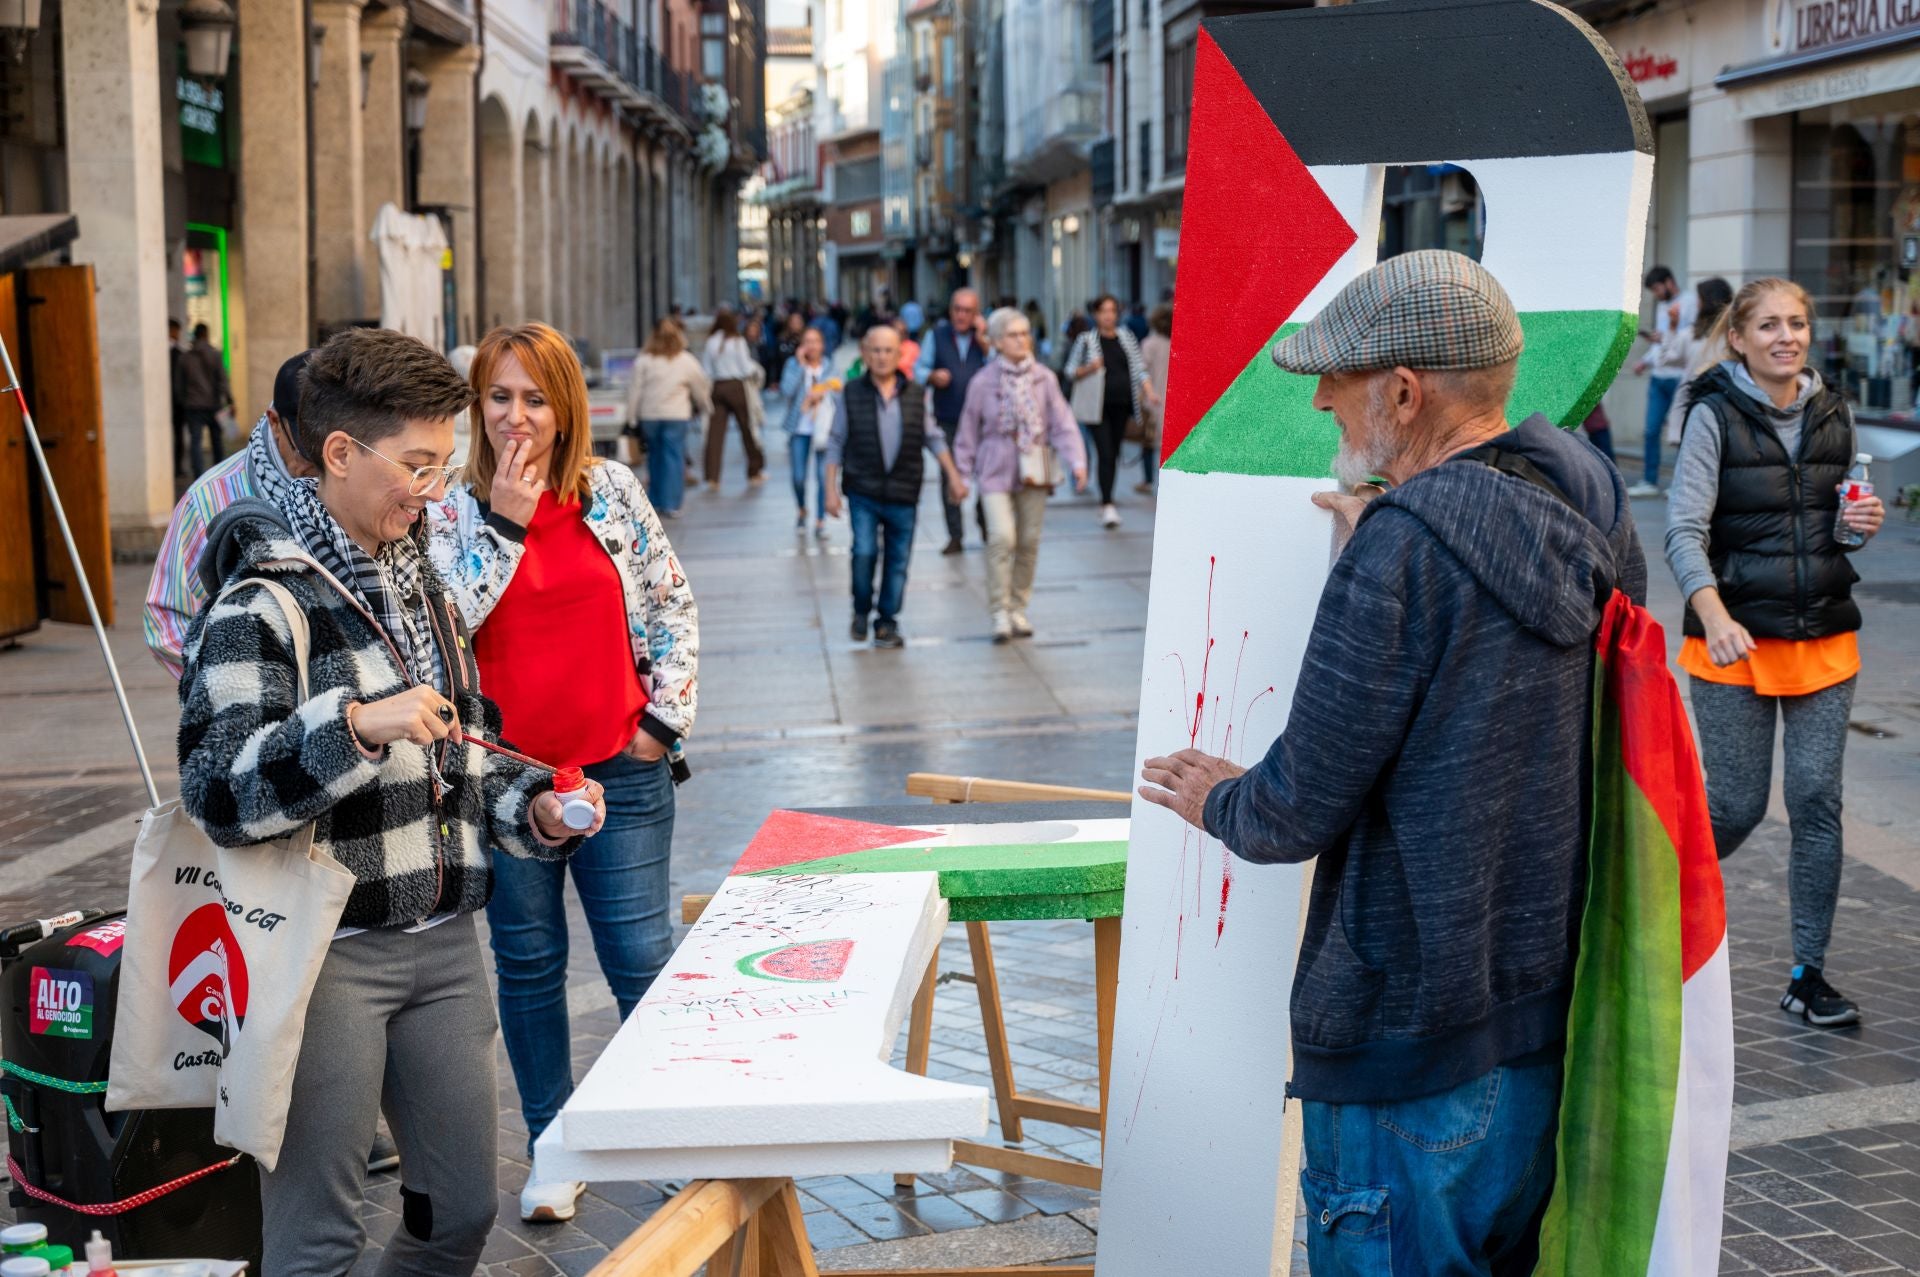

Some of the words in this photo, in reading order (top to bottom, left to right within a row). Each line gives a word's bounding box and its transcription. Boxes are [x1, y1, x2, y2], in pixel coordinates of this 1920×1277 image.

[1797, 0, 1881, 49] LIBRERIA
[175, 866, 201, 885] VII
[245, 908, 287, 932] CGT
[37, 979, 82, 1011] ALTO
[708, 999, 848, 1022] LIBRE
[37, 1008, 45, 1020] AL
[45, 1010, 82, 1024] GENOCIDIO
